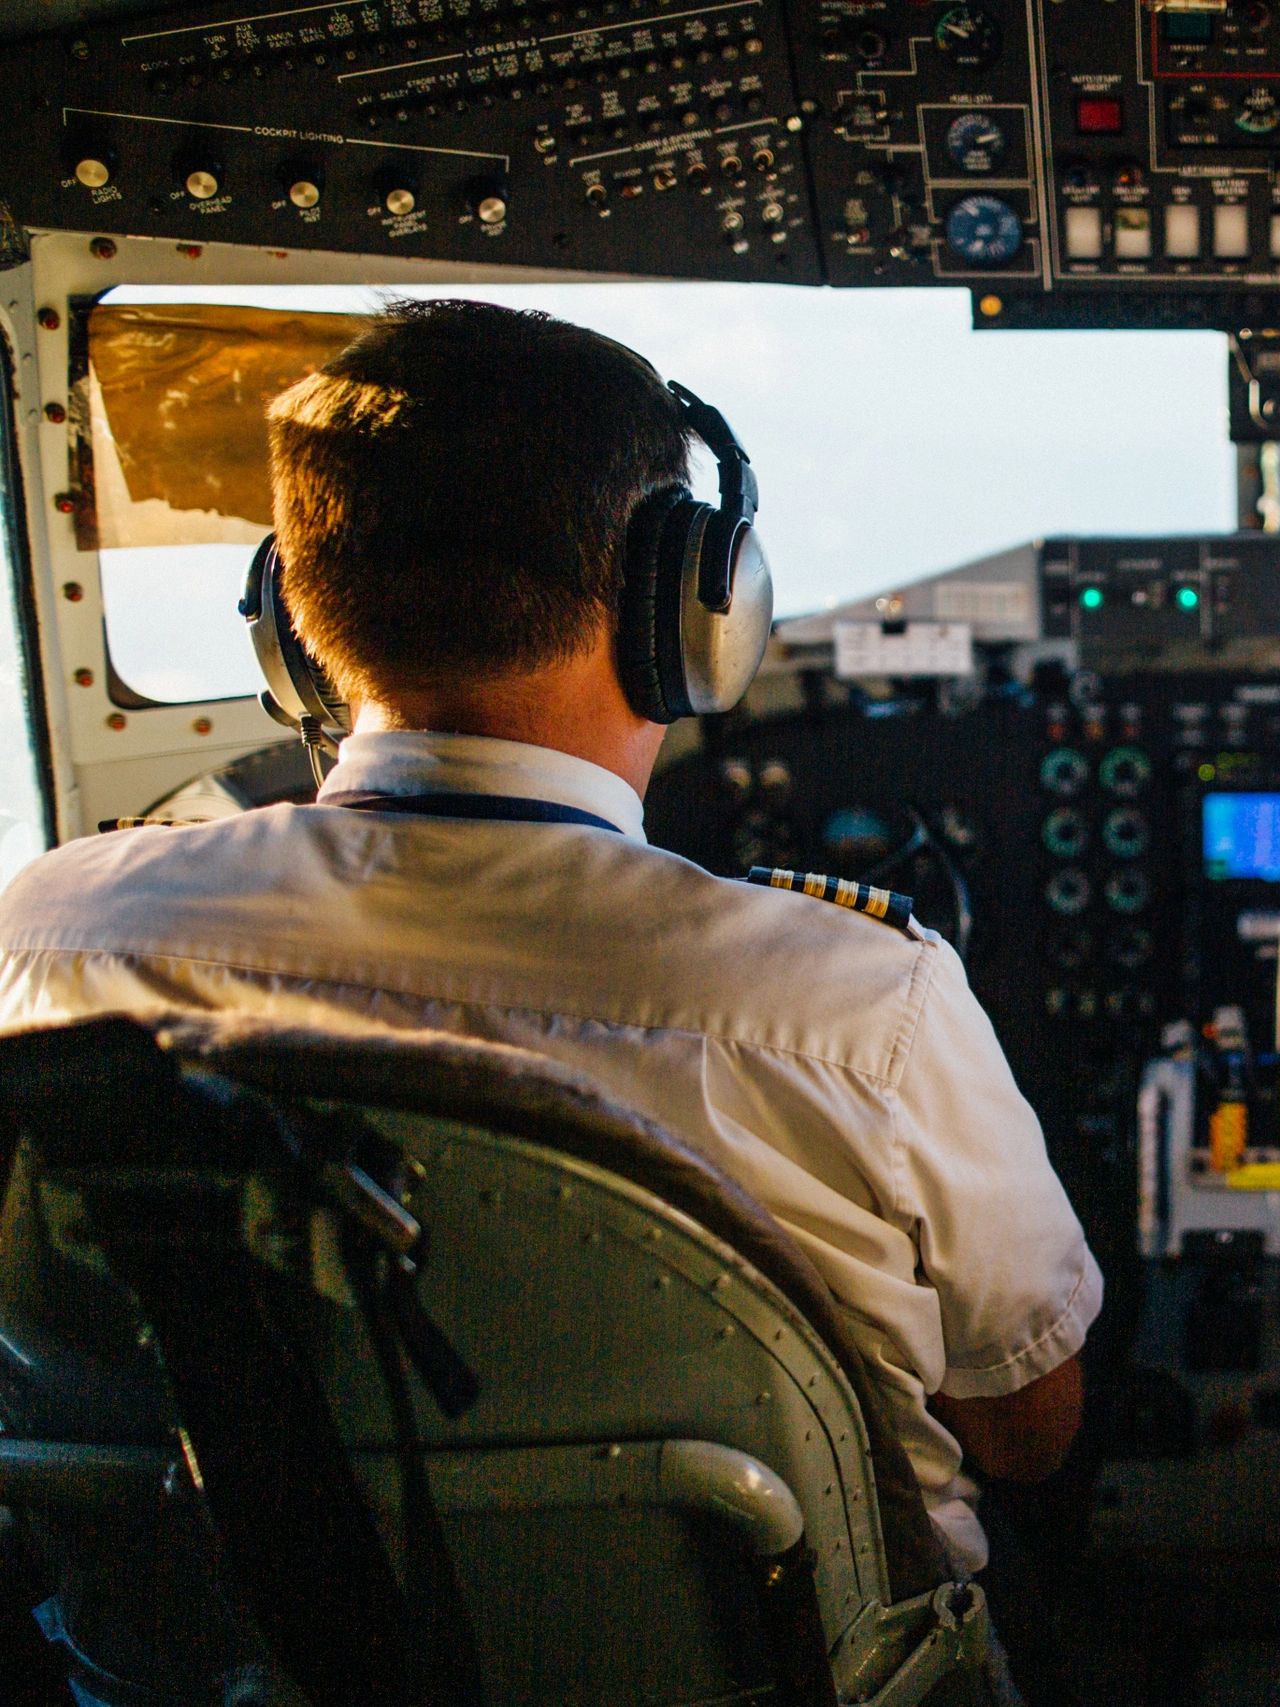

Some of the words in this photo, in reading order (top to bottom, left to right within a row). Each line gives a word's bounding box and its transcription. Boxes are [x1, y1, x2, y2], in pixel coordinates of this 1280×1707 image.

[203, 35, 226, 46] TURN
[254, 126, 297, 139] COCKPIT
[300, 131, 344, 144] LIGHTING
[61, 178, 76, 188] OFF
[91, 185, 118, 196] RADIO
[170, 190, 185, 200] OFF
[93, 193, 122, 205] LIGHTS
[189, 196, 233, 211] OVERHEAD
[200, 205, 227, 214] PANEL
